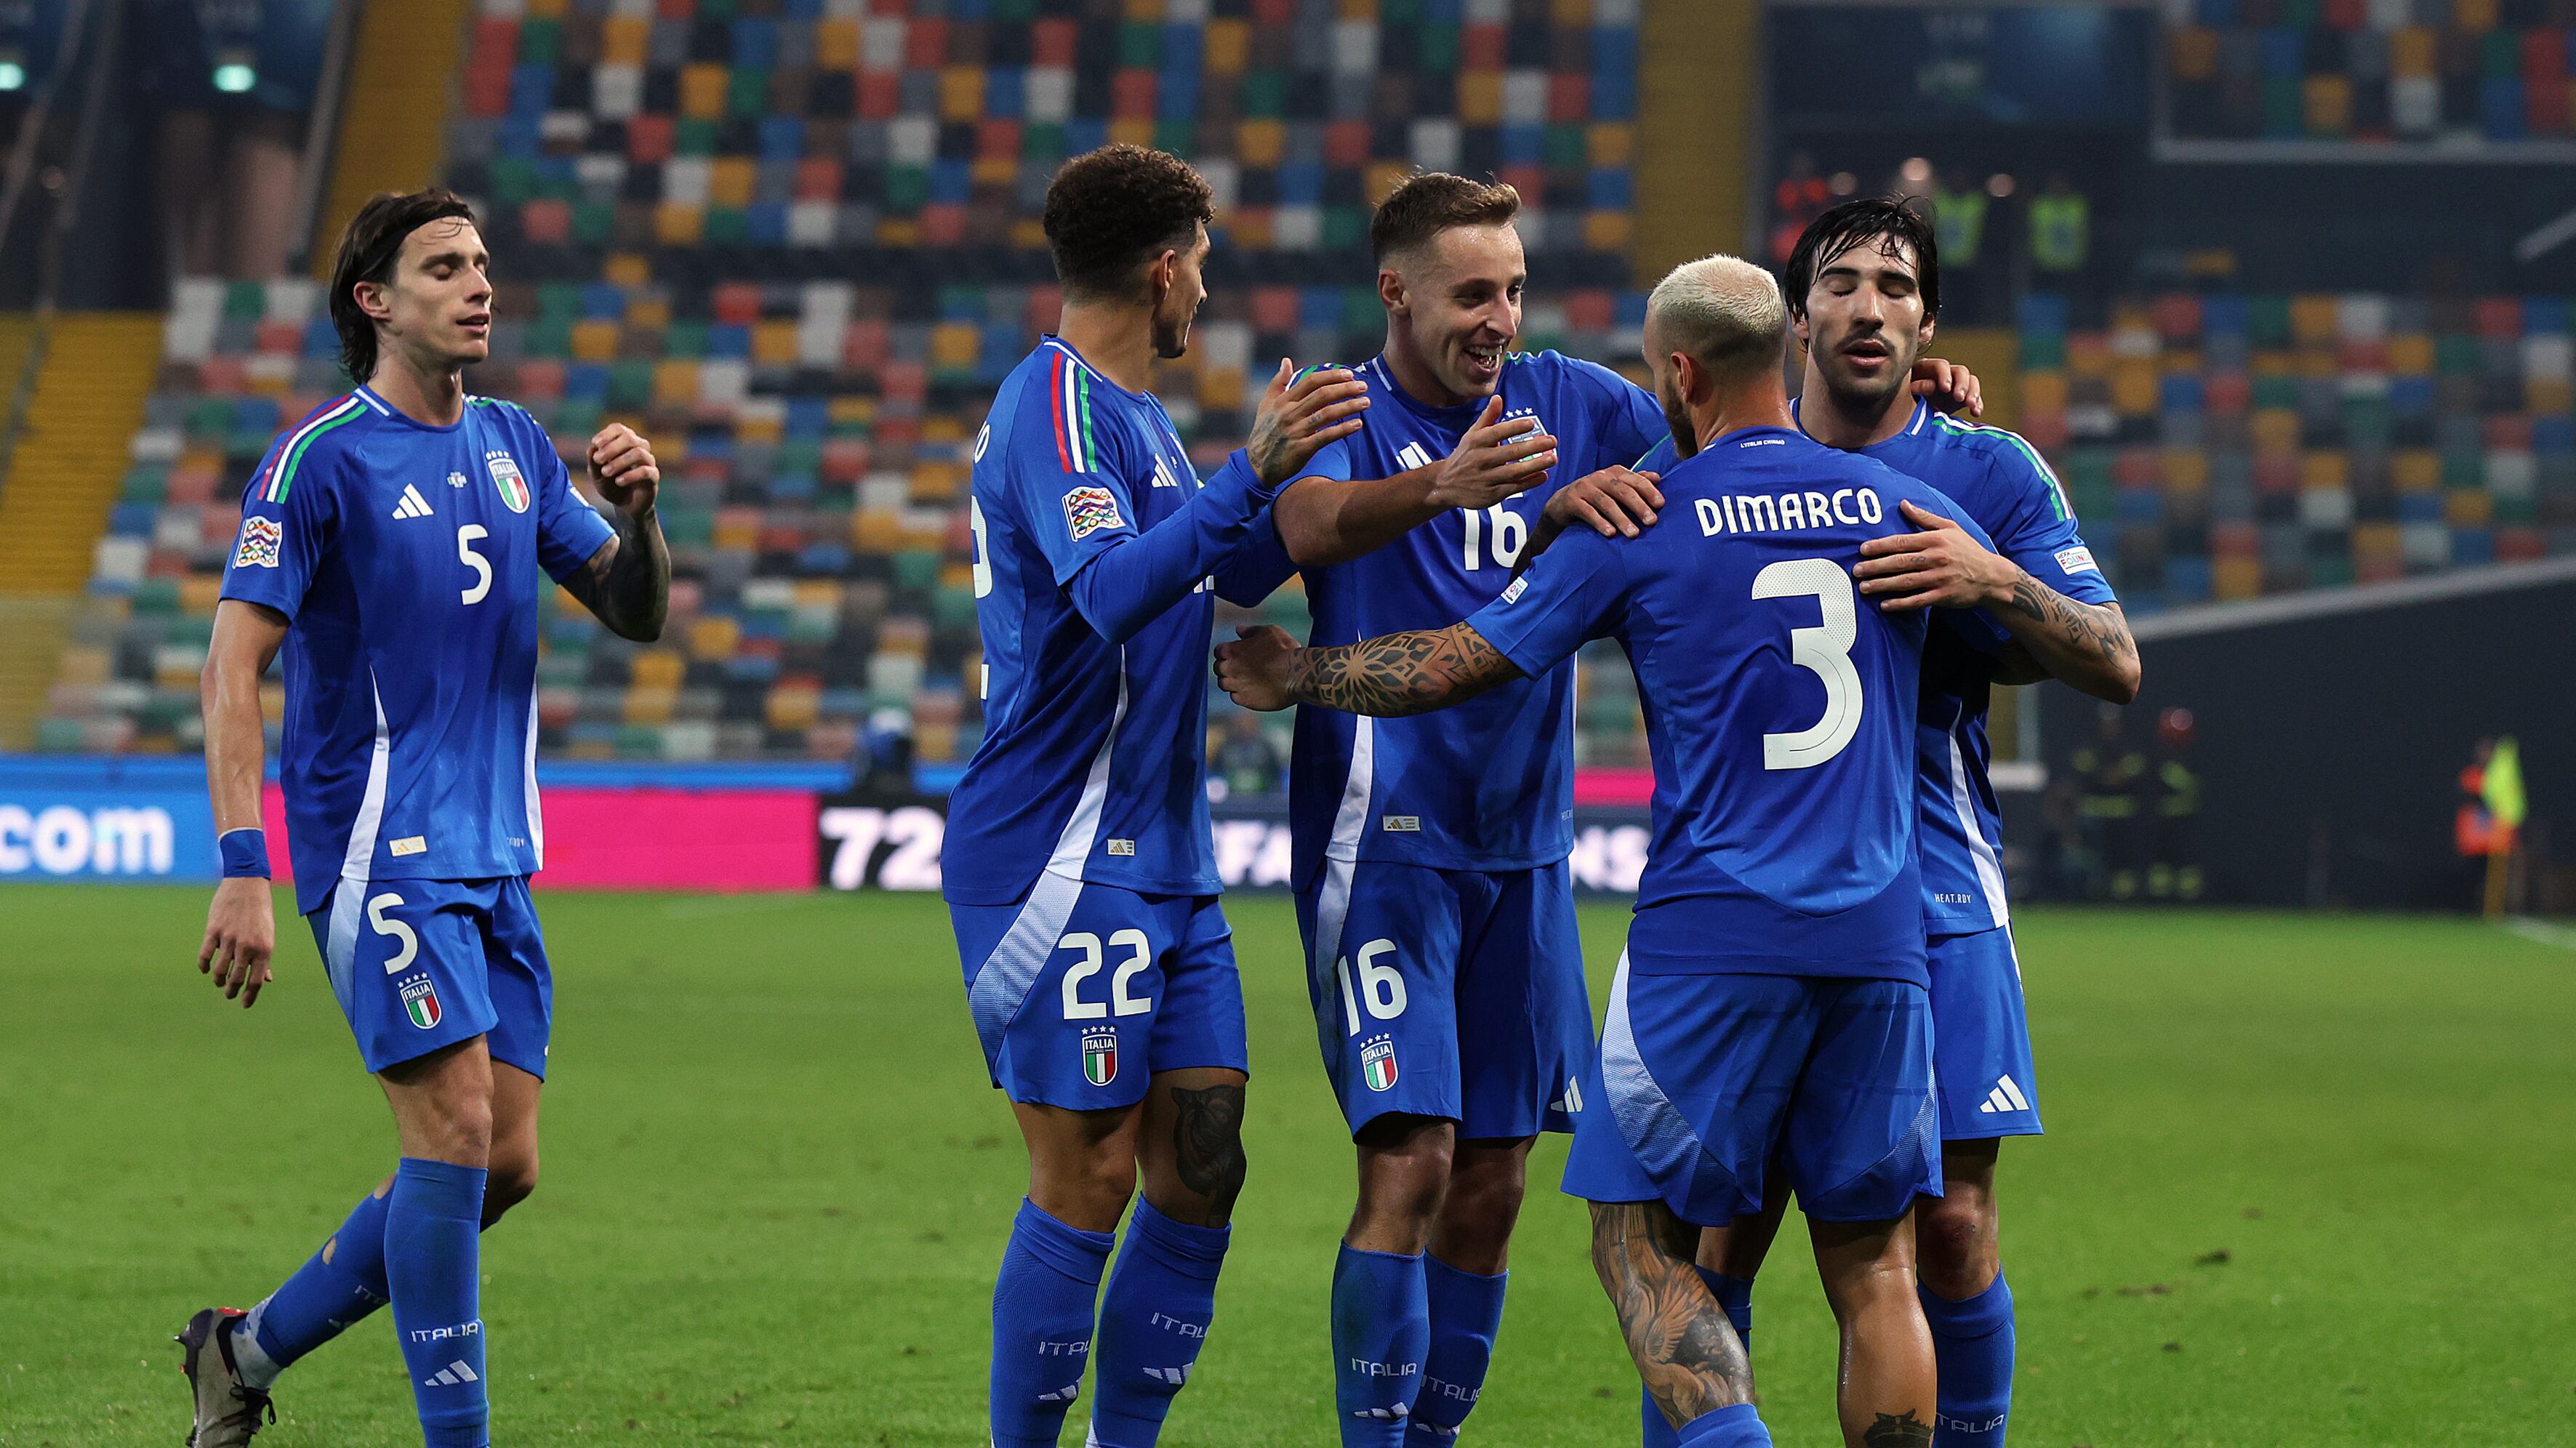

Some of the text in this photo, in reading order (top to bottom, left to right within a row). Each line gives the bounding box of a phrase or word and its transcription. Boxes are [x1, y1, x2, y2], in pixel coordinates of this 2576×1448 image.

[1463, 491, 1528, 571] 16
[1695, 488, 1883, 538] DIMARCO
[457, 524, 492, 606] 5
[1751, 558, 1863, 771] 3
[0, 806, 175, 874] com
[819, 807, 944, 891] 72
[1934, 893, 1971, 904] HEAT.RDY
[367, 893, 418, 975] 5
[404, 984, 431, 1000] ITALIA
[1058, 928, 1152, 1020] 22
[1337, 938, 1408, 1037] 16
[1086, 1038, 1114, 1050] ITALIA
[1364, 1045, 1391, 1062] ITALIA
[410, 1322, 479, 1343] ITALIA
[1352, 1357, 1417, 1377] ITALIA
[1936, 1414, 2005, 1433] TALIA
